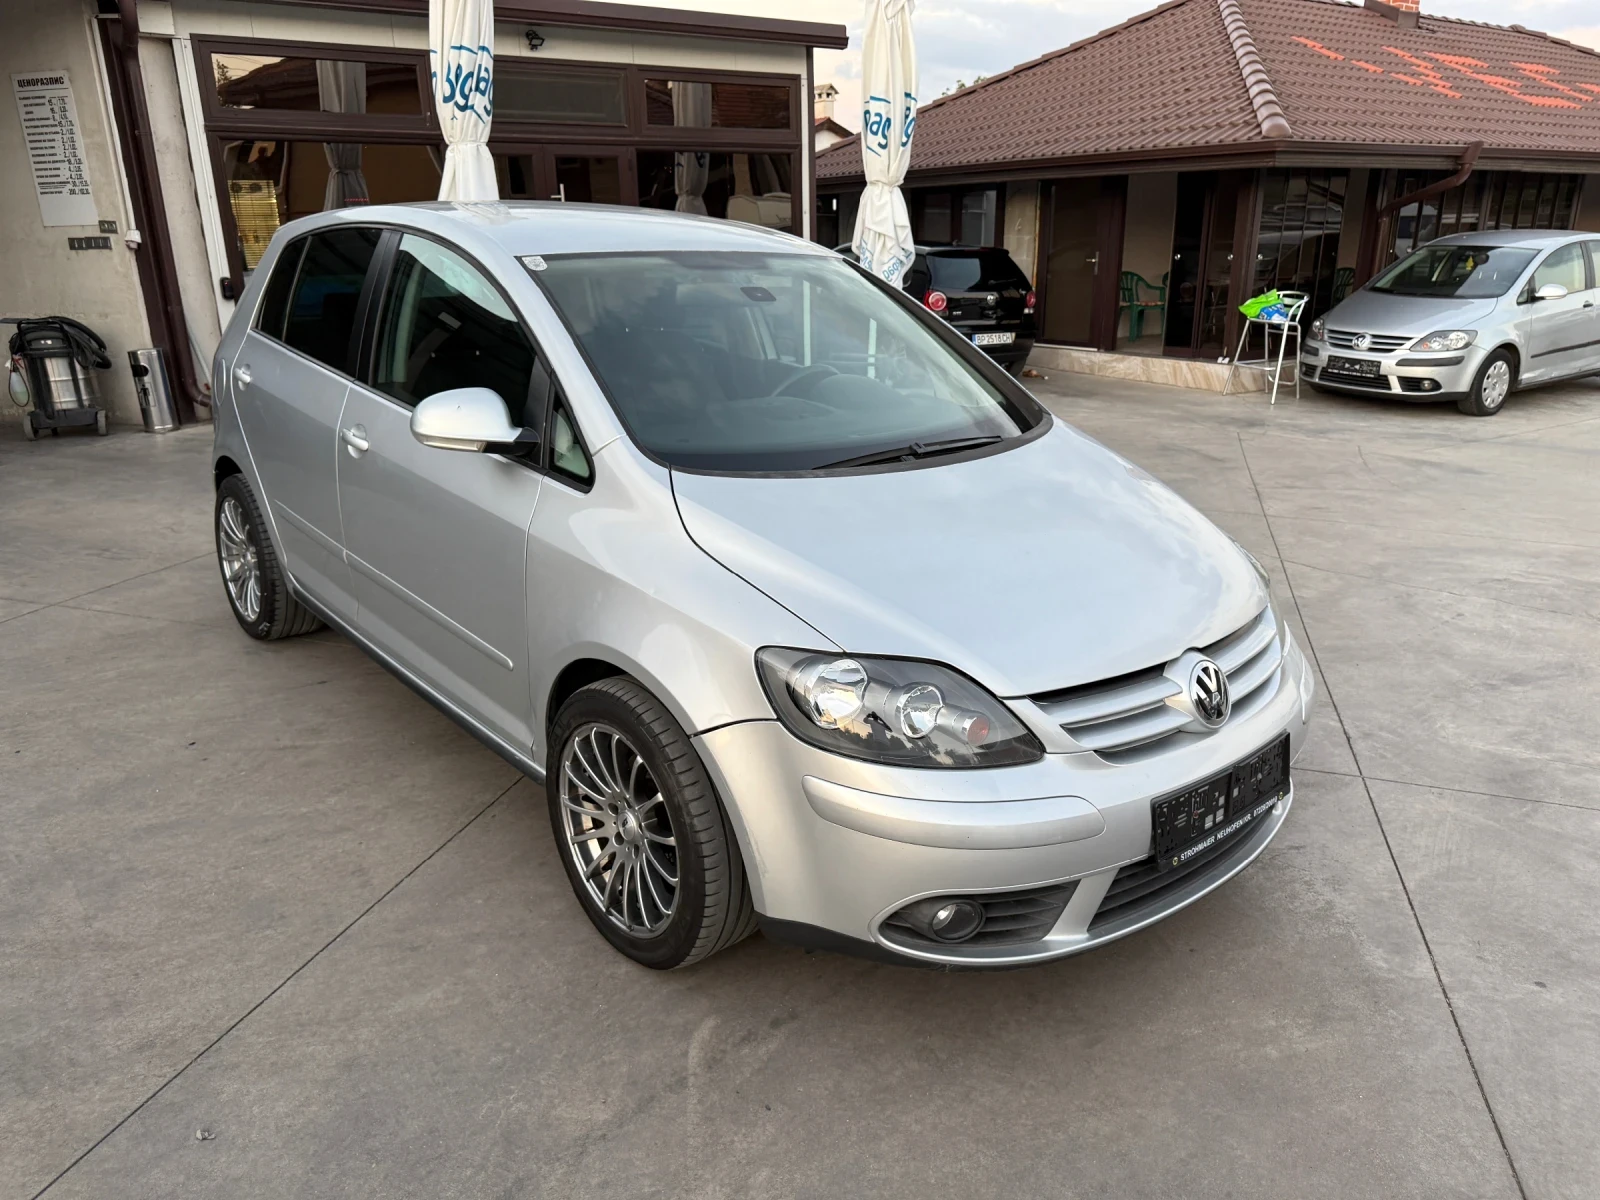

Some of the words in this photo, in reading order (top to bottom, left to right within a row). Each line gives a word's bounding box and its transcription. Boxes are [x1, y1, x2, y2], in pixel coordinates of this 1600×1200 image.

[17, 77, 64, 88] ЦЕНОРАЗПИС
[986, 334, 1001, 344] 2518
[1181, 836, 1215, 860] STROHMAIER
